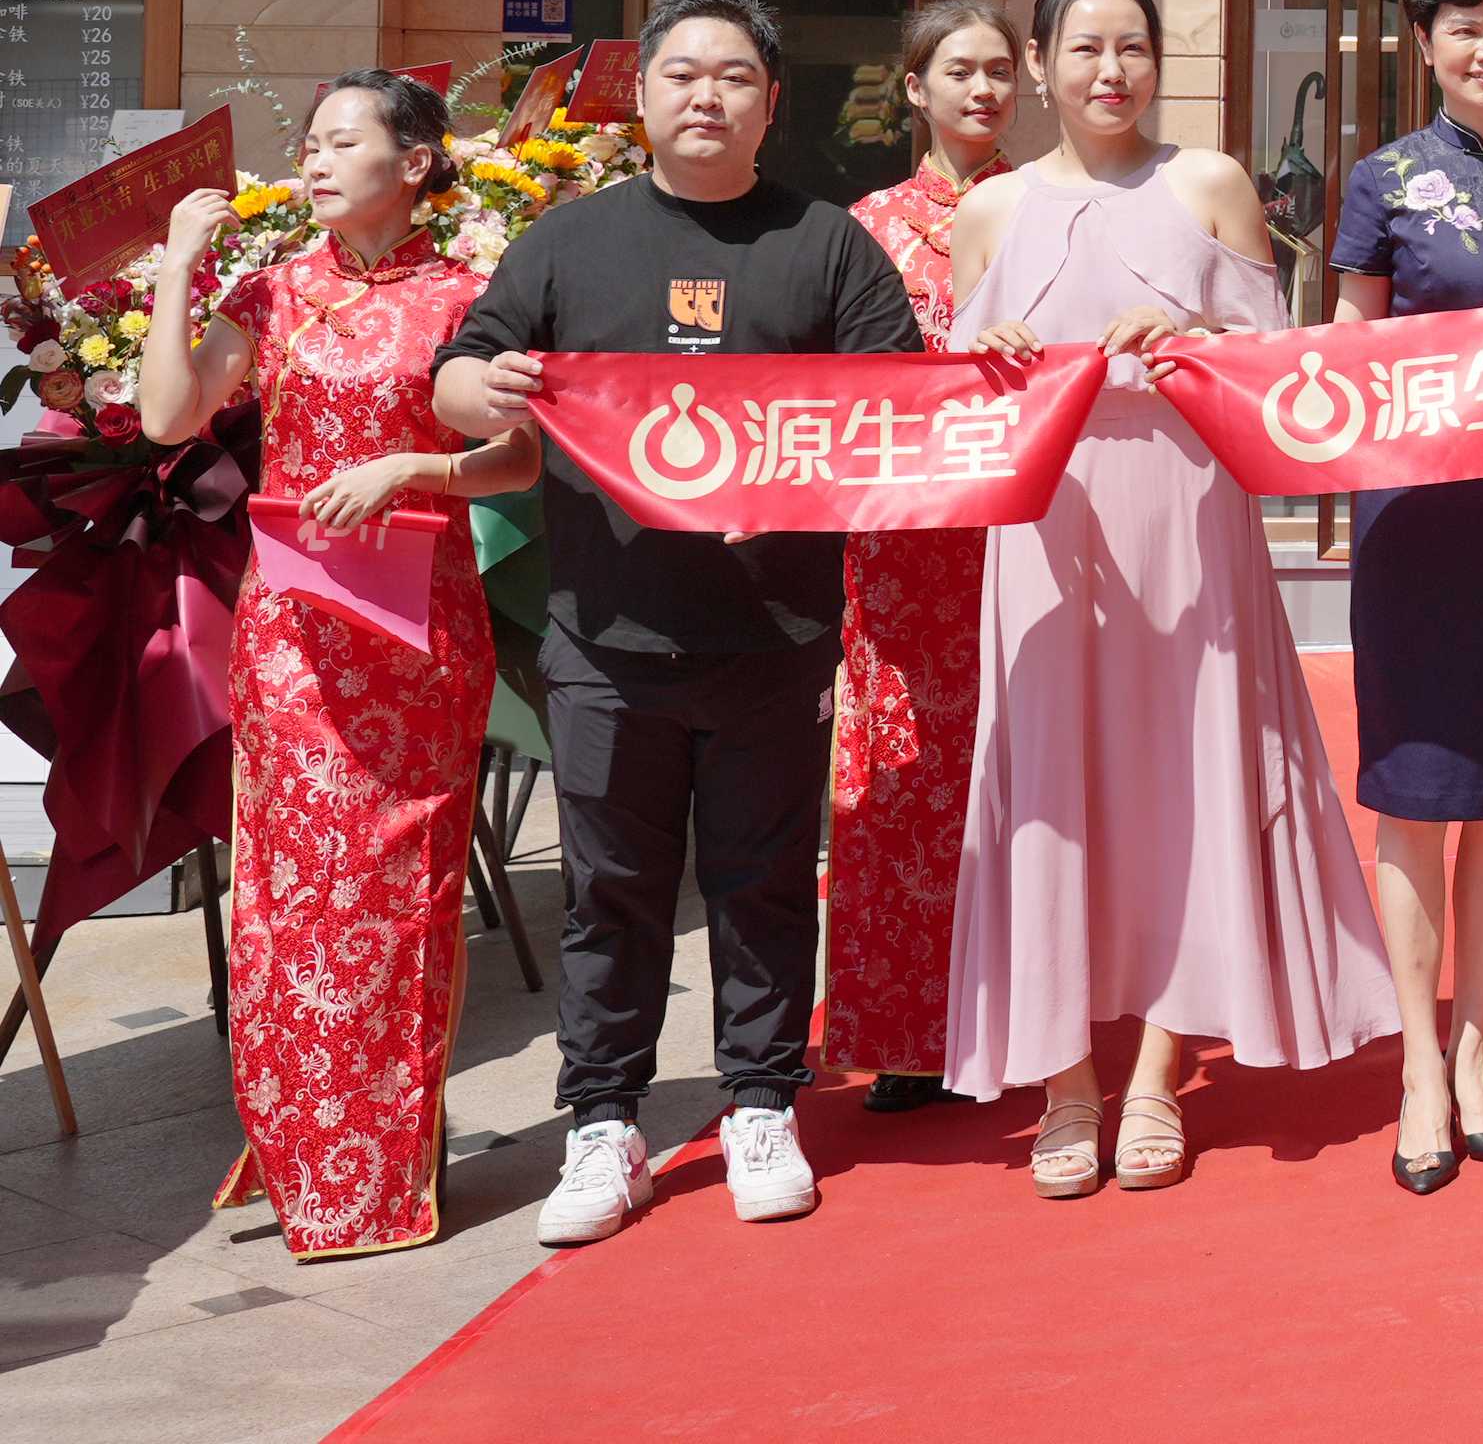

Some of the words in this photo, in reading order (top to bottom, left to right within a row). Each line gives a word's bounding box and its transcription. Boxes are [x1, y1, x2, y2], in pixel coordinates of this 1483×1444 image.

[82, 5, 112, 21] ¥20
[82, 27, 112, 44] ¥26
[81, 49, 111, 66] ¥25
[80, 71, 111, 88] ¥28
[740, 394, 1020, 486] 源生堂
